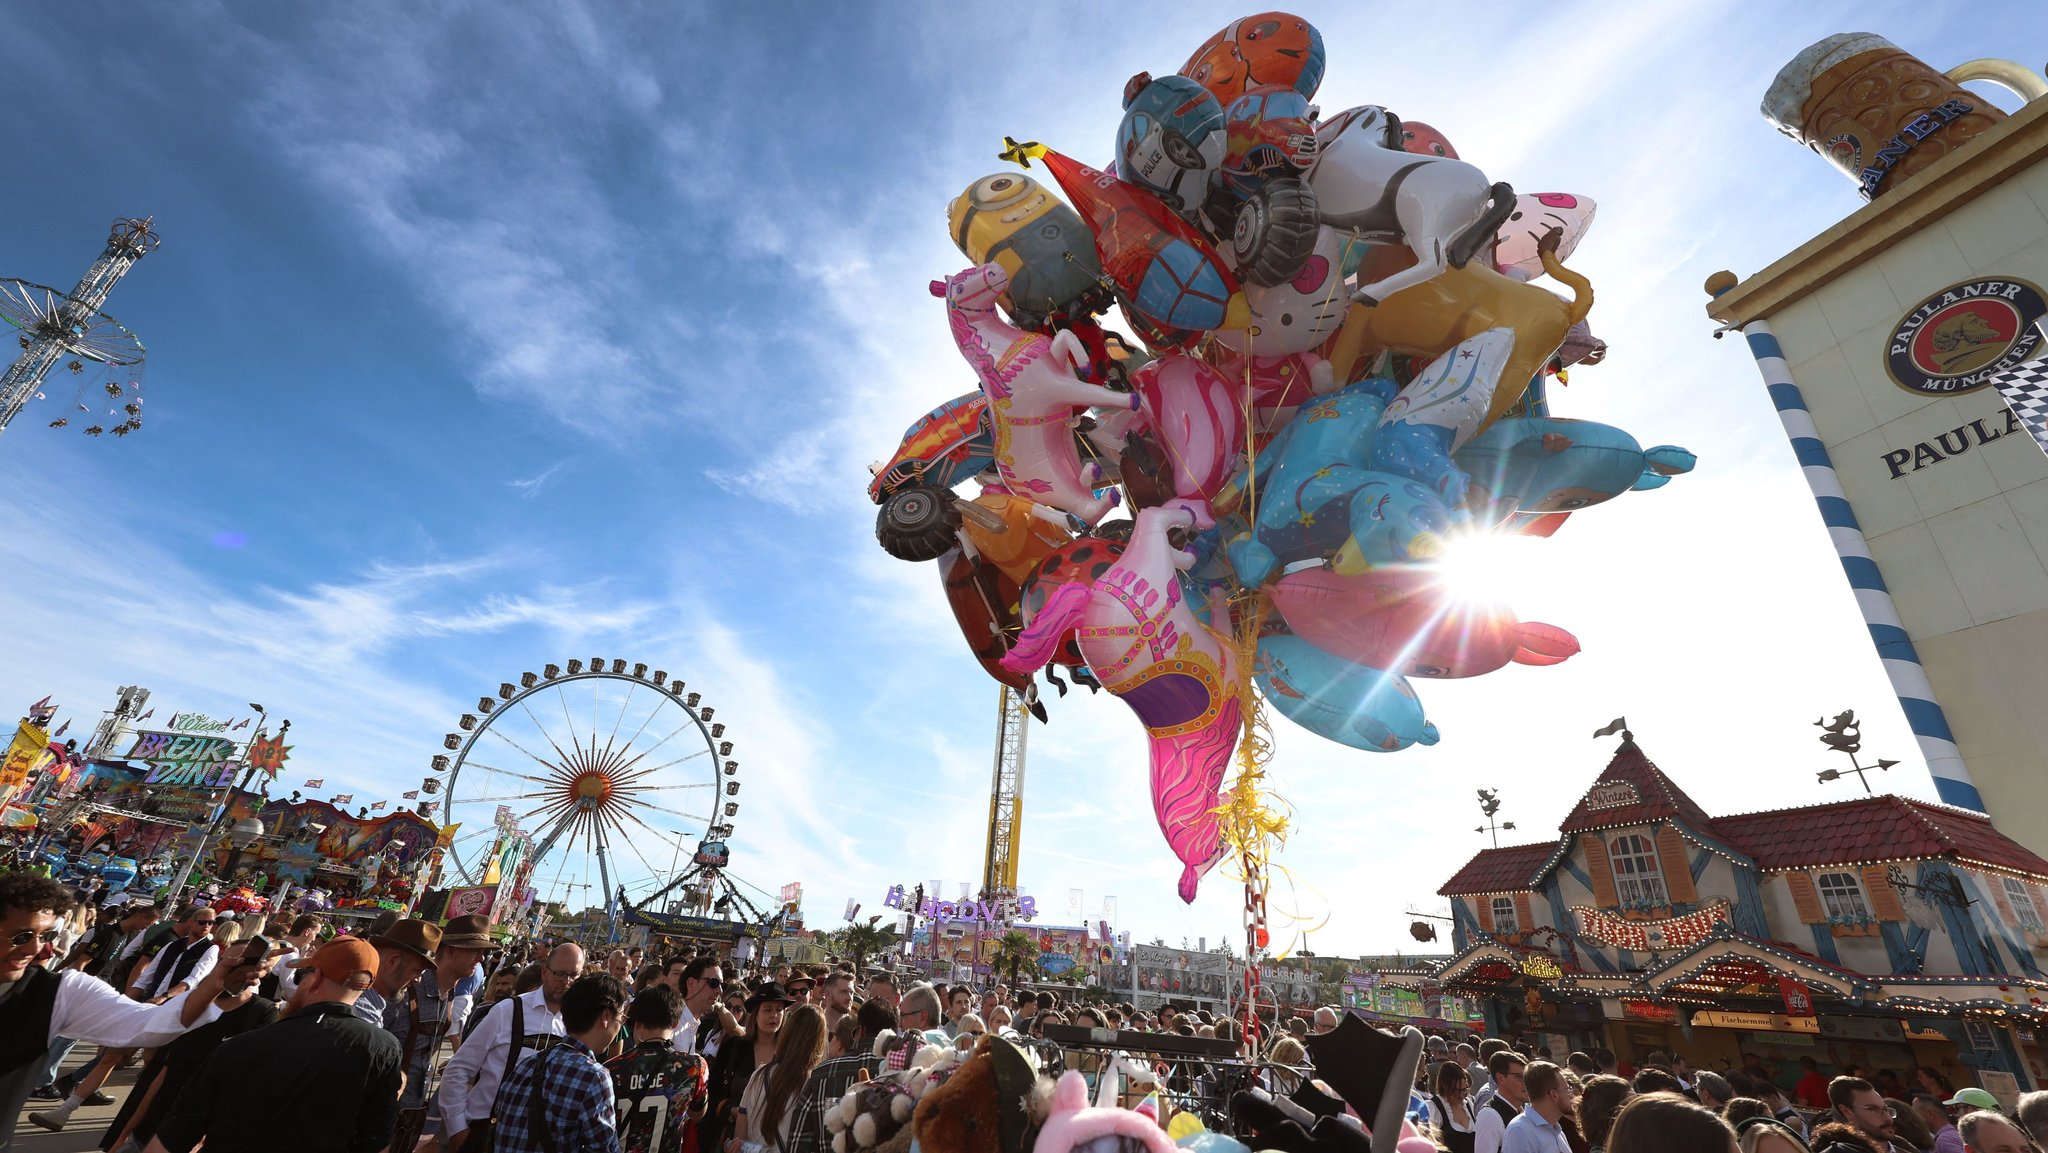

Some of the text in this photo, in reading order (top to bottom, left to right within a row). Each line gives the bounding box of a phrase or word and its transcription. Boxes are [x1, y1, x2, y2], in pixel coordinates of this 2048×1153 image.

[1140, 148, 1163, 179] POLICE
[1859, 98, 1974, 203] ANER
[1891, 281, 2023, 356] PAULANER
[1922, 332, 2038, 391] MÜNCHEN
[132, 733, 231, 762] BREAK
[144, 760, 239, 787] DANCE
[1592, 790, 1635, 806] Winters
[1582, 909, 1649, 949] FISCH
[1721, 1015, 1774, 1027] Fischsemmel
